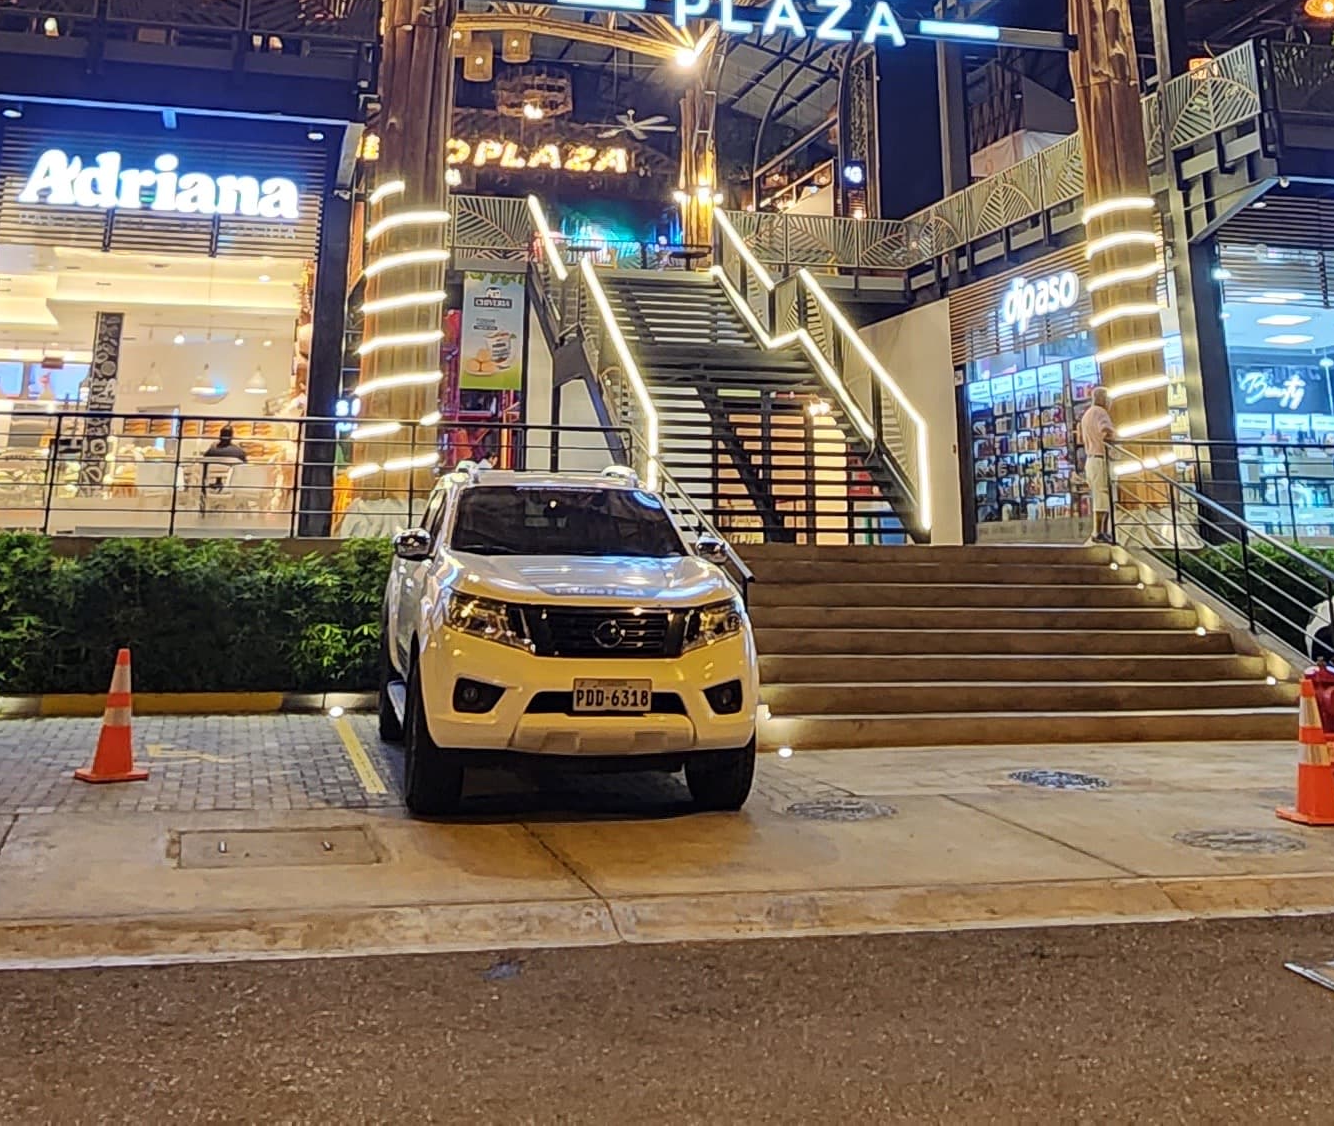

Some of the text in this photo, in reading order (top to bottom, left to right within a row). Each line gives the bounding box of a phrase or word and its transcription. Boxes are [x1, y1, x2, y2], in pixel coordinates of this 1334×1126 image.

[17, 148, 300, 219] Adriana
[1001, 270, 1081, 334] dipaso
[575, 688, 650, 708] PDD-6318
